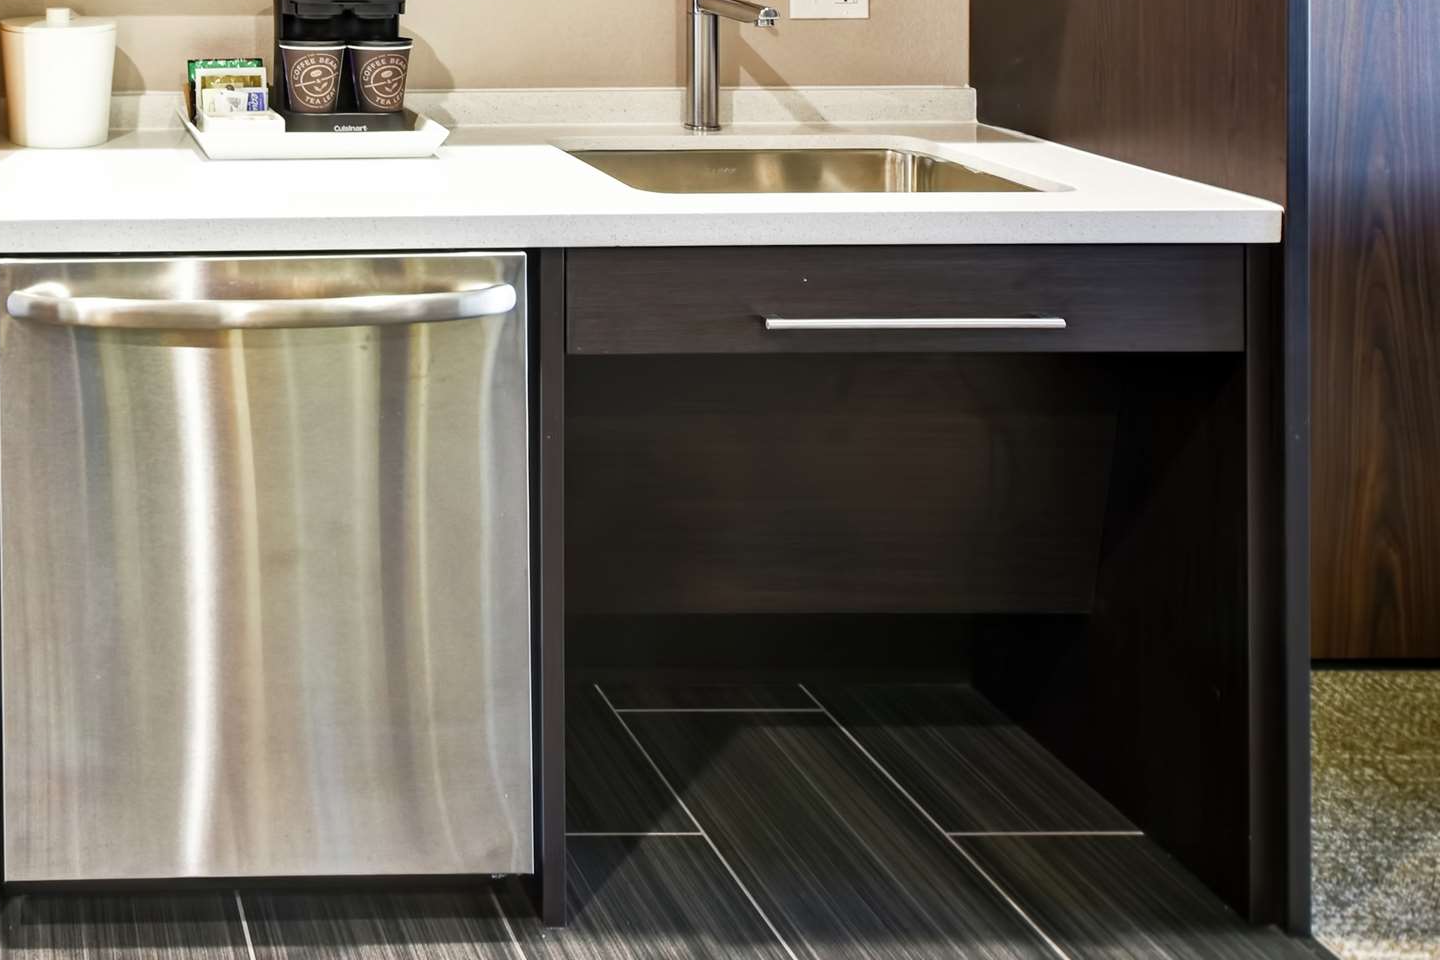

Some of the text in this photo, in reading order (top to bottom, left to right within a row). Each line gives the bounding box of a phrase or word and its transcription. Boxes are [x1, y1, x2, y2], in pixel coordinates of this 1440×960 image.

[293, 57, 337, 81] COFFEE BEAN
[363, 58, 387, 81] COFFEE
[305, 96, 321, 105] TEA
[376, 96, 391, 105] TEA
